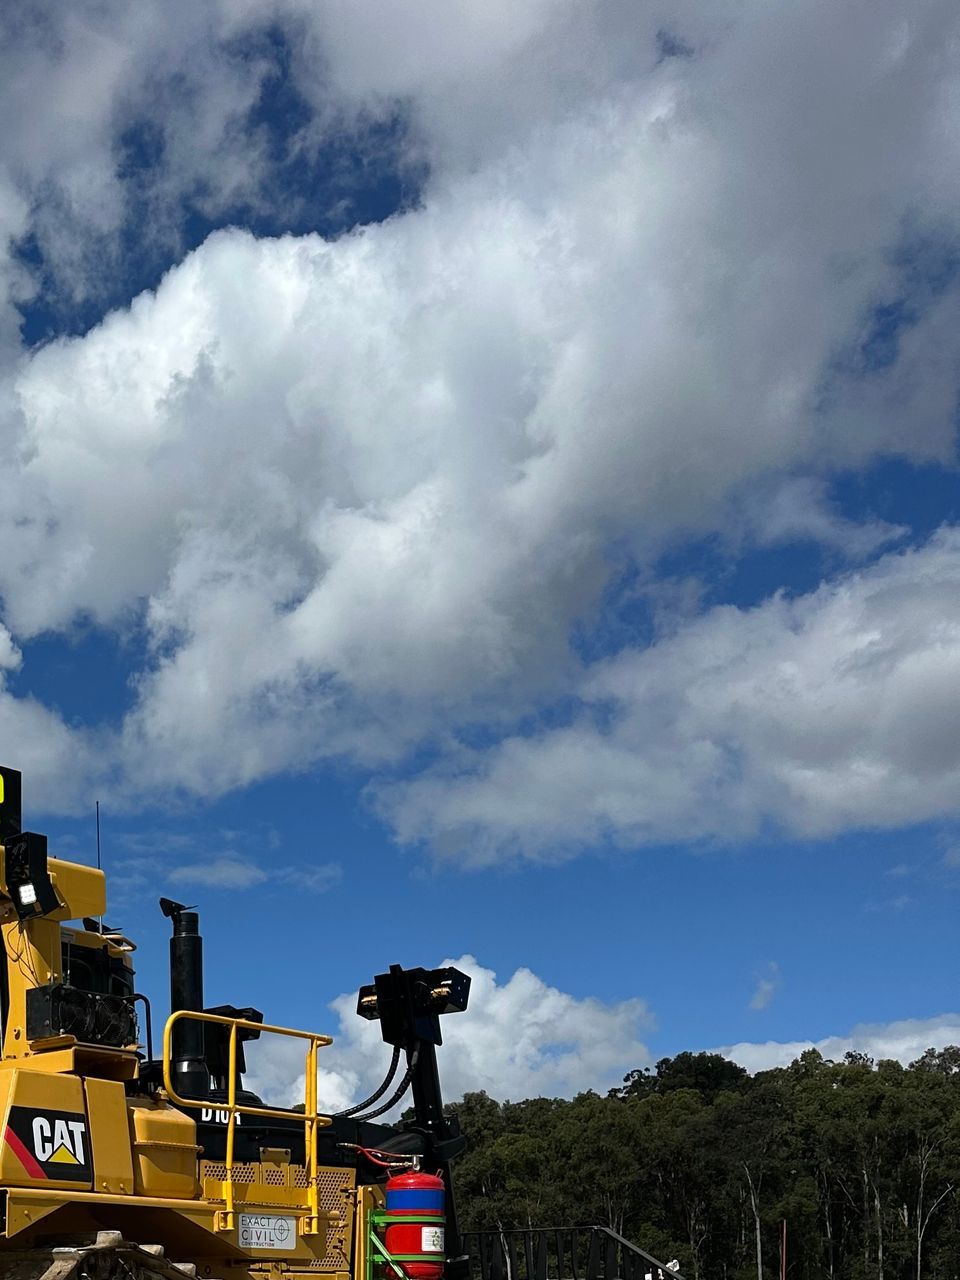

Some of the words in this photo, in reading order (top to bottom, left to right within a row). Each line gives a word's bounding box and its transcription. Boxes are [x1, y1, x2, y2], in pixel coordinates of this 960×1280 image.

[32, 1117, 86, 1165] CAT
[241, 1215, 272, 1227] EXACT
[241, 1229, 275, 1242] CIVIL
